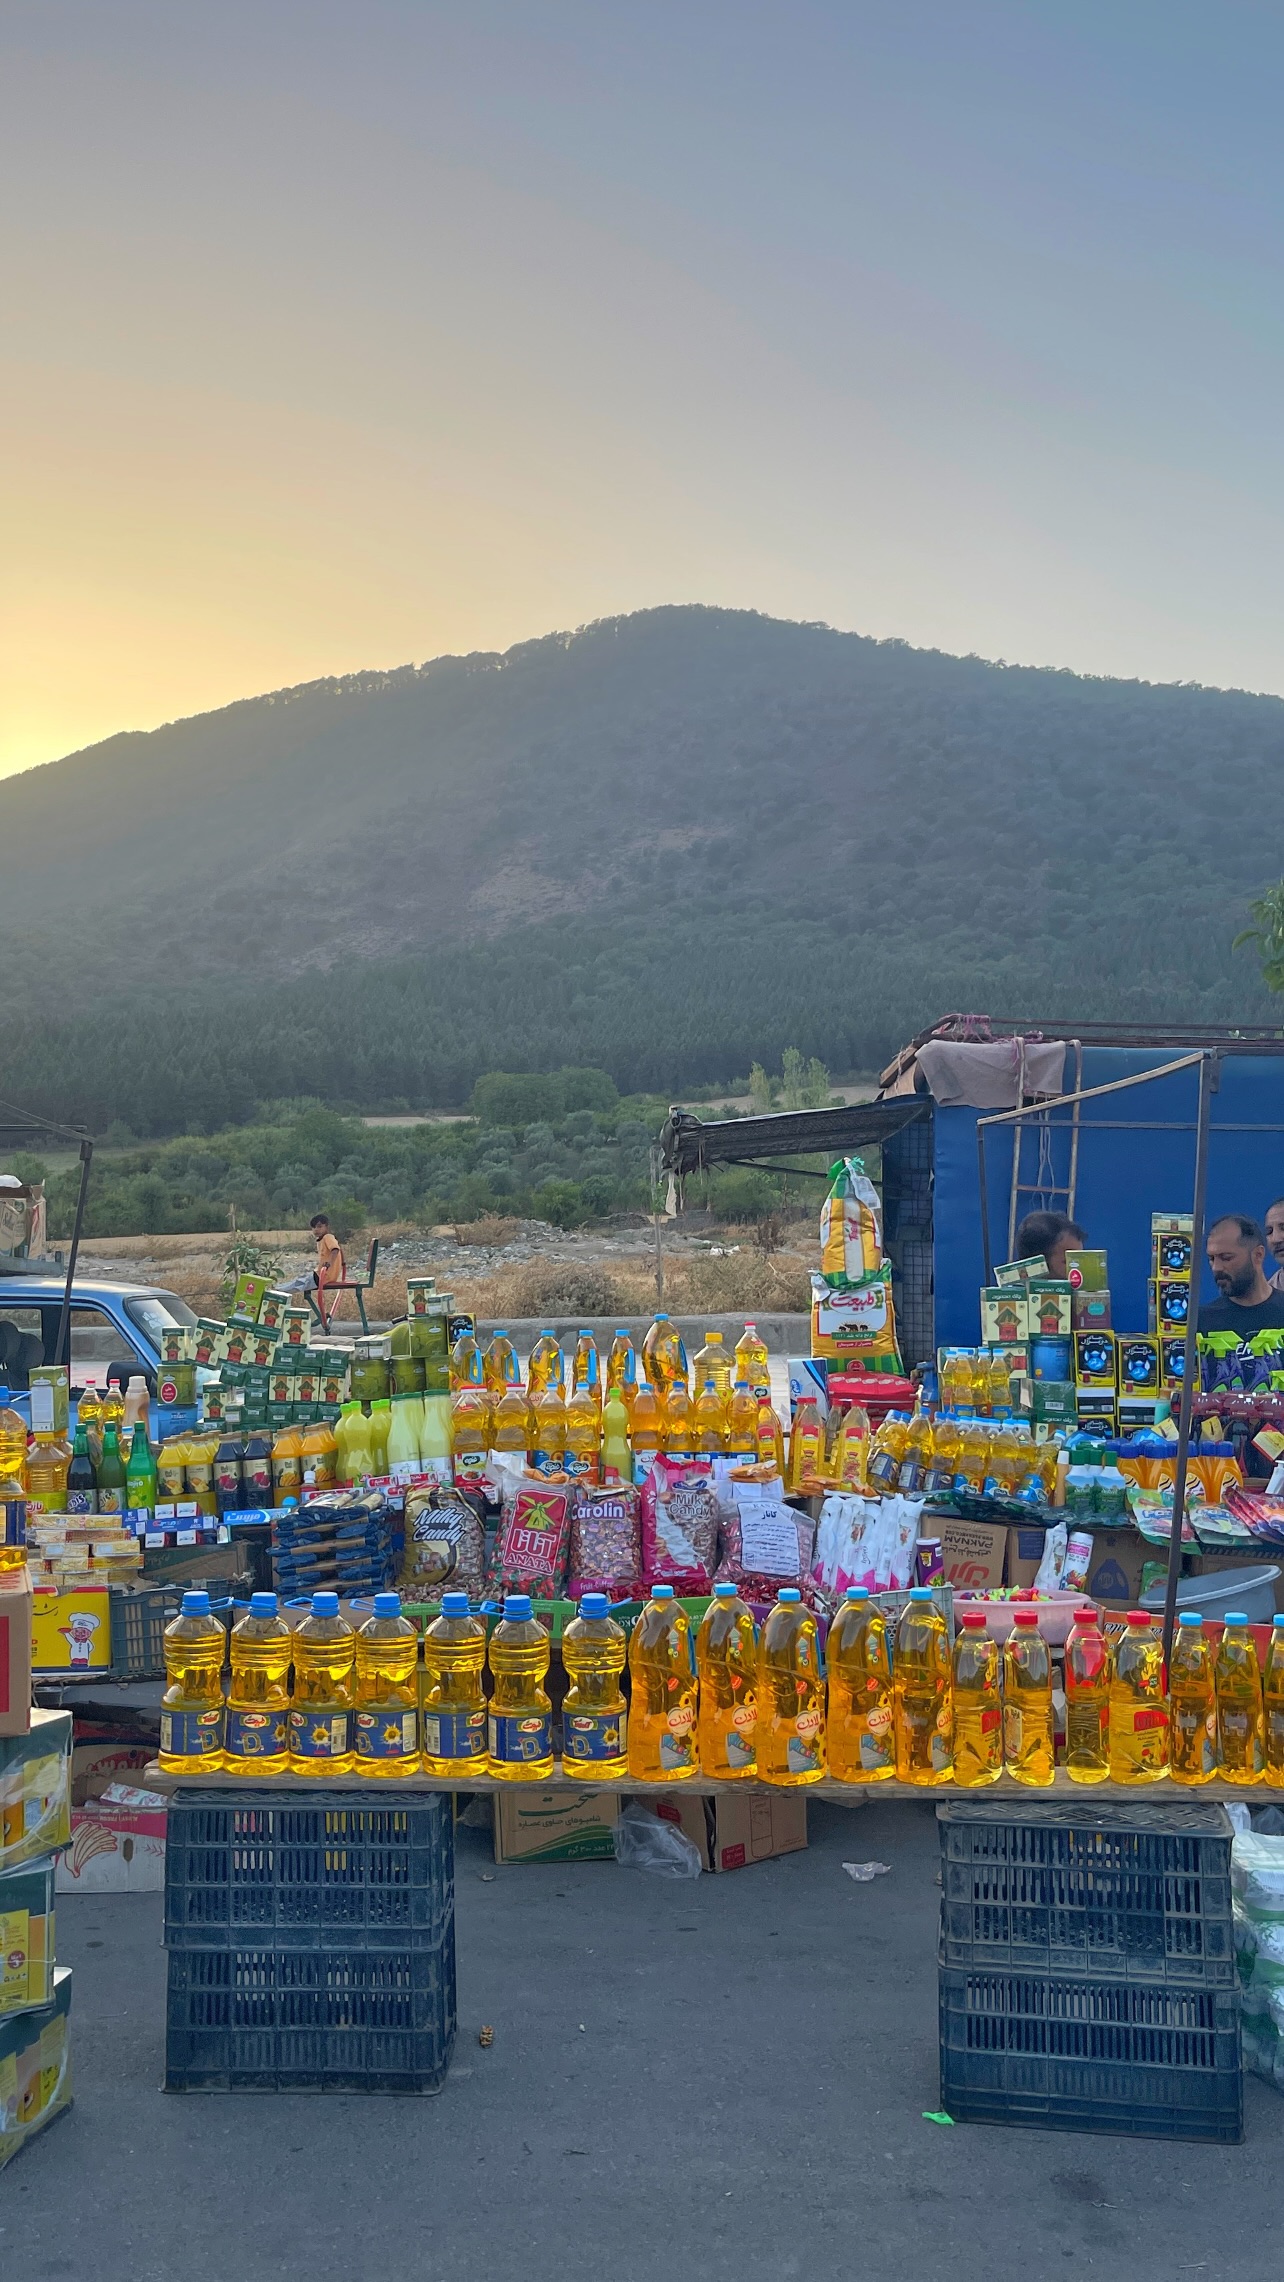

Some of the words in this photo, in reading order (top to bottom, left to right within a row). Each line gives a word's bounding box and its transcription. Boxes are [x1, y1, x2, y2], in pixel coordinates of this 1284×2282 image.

[831, 1291, 875, 1311] طبیعت
[676, 1492, 703, 1506] Milk
[415, 1507, 465, 1527] Milky
[572, 1501, 625, 1521] Carolin
[669, 1503, 711, 1518] Candy
[412, 1523, 466, 1545] Candy
[943, 1535, 994, 1549] PAKNAM
[505, 1552, 553, 1574] ANATA
